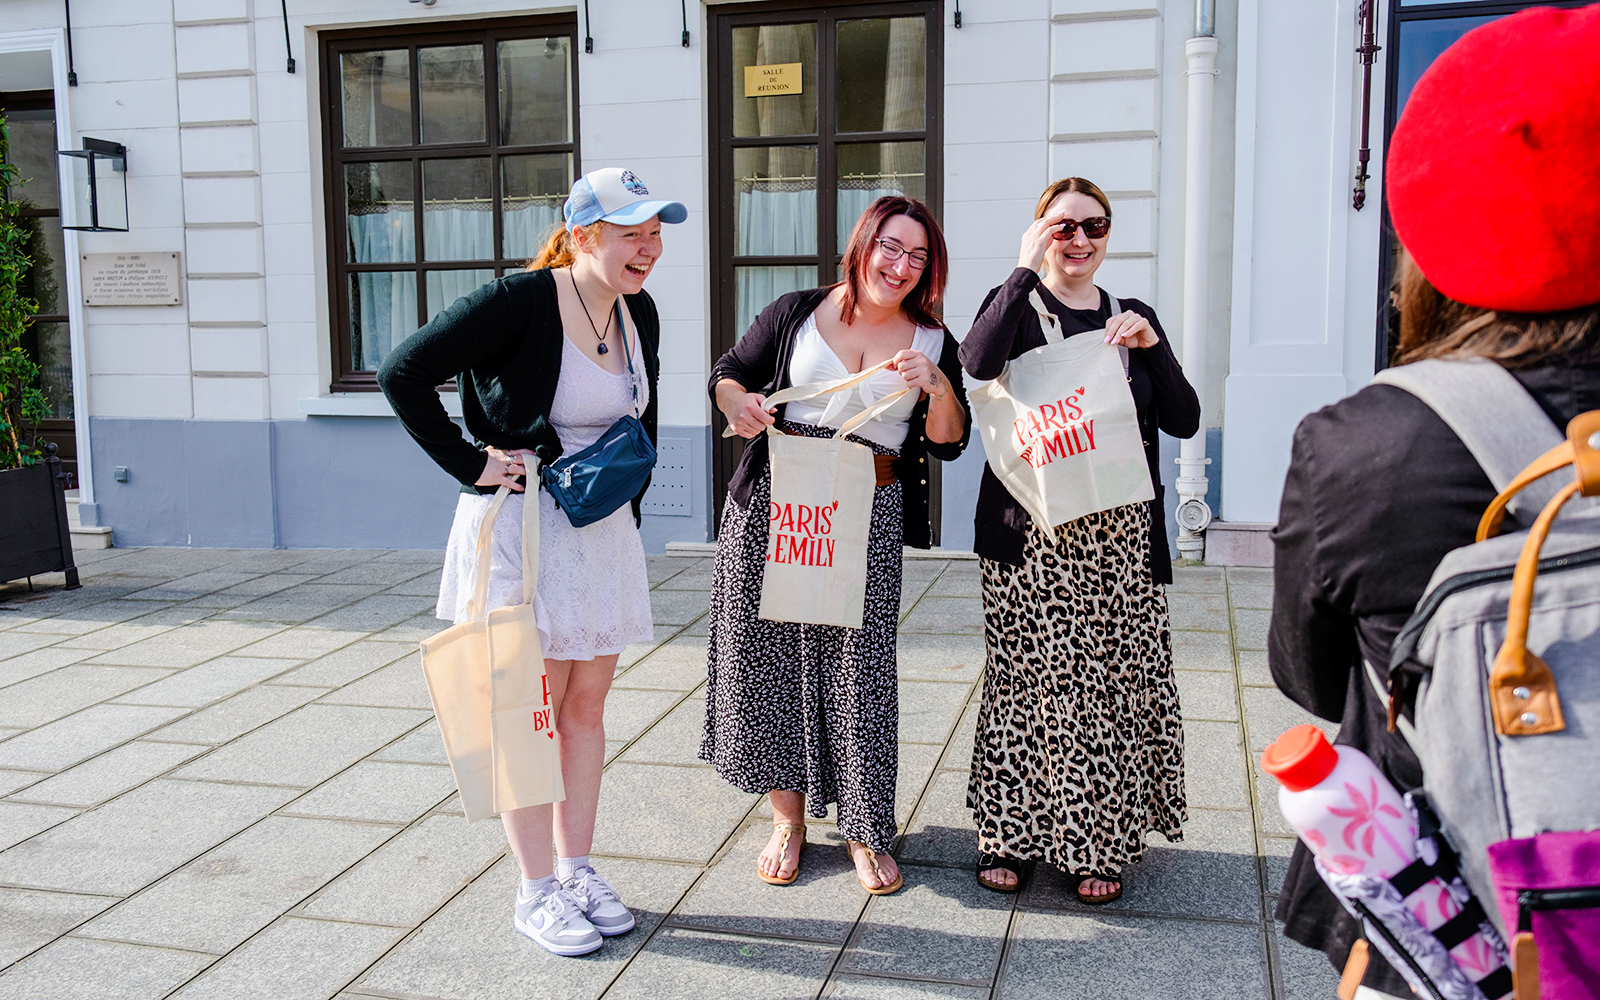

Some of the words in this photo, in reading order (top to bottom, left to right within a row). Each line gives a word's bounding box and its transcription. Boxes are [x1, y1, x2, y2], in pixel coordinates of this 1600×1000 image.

[762, 68, 784, 76] SALLE
[1013, 395, 1083, 446] PARIS
[1033, 418, 1097, 469] EMILY
[774, 533, 836, 568] EMILY
[533, 708, 551, 731] BY
